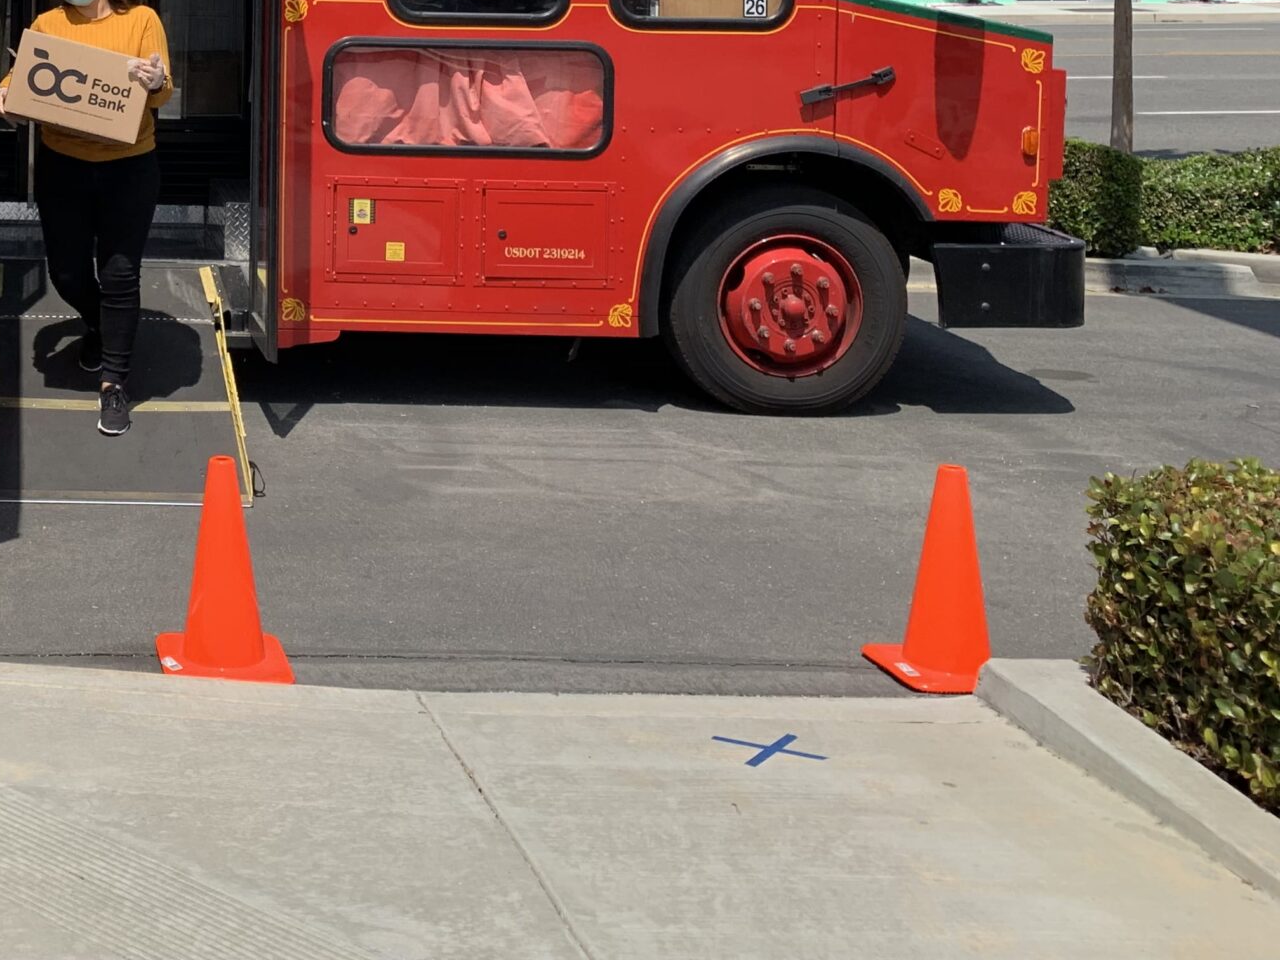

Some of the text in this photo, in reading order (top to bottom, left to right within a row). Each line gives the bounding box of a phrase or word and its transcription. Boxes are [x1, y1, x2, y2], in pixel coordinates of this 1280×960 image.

[27, 62, 88, 104] OC
[91, 78, 132, 99] Food
[88, 93, 126, 113] Bank
[504, 246, 586, 260] USDOT 2319214
